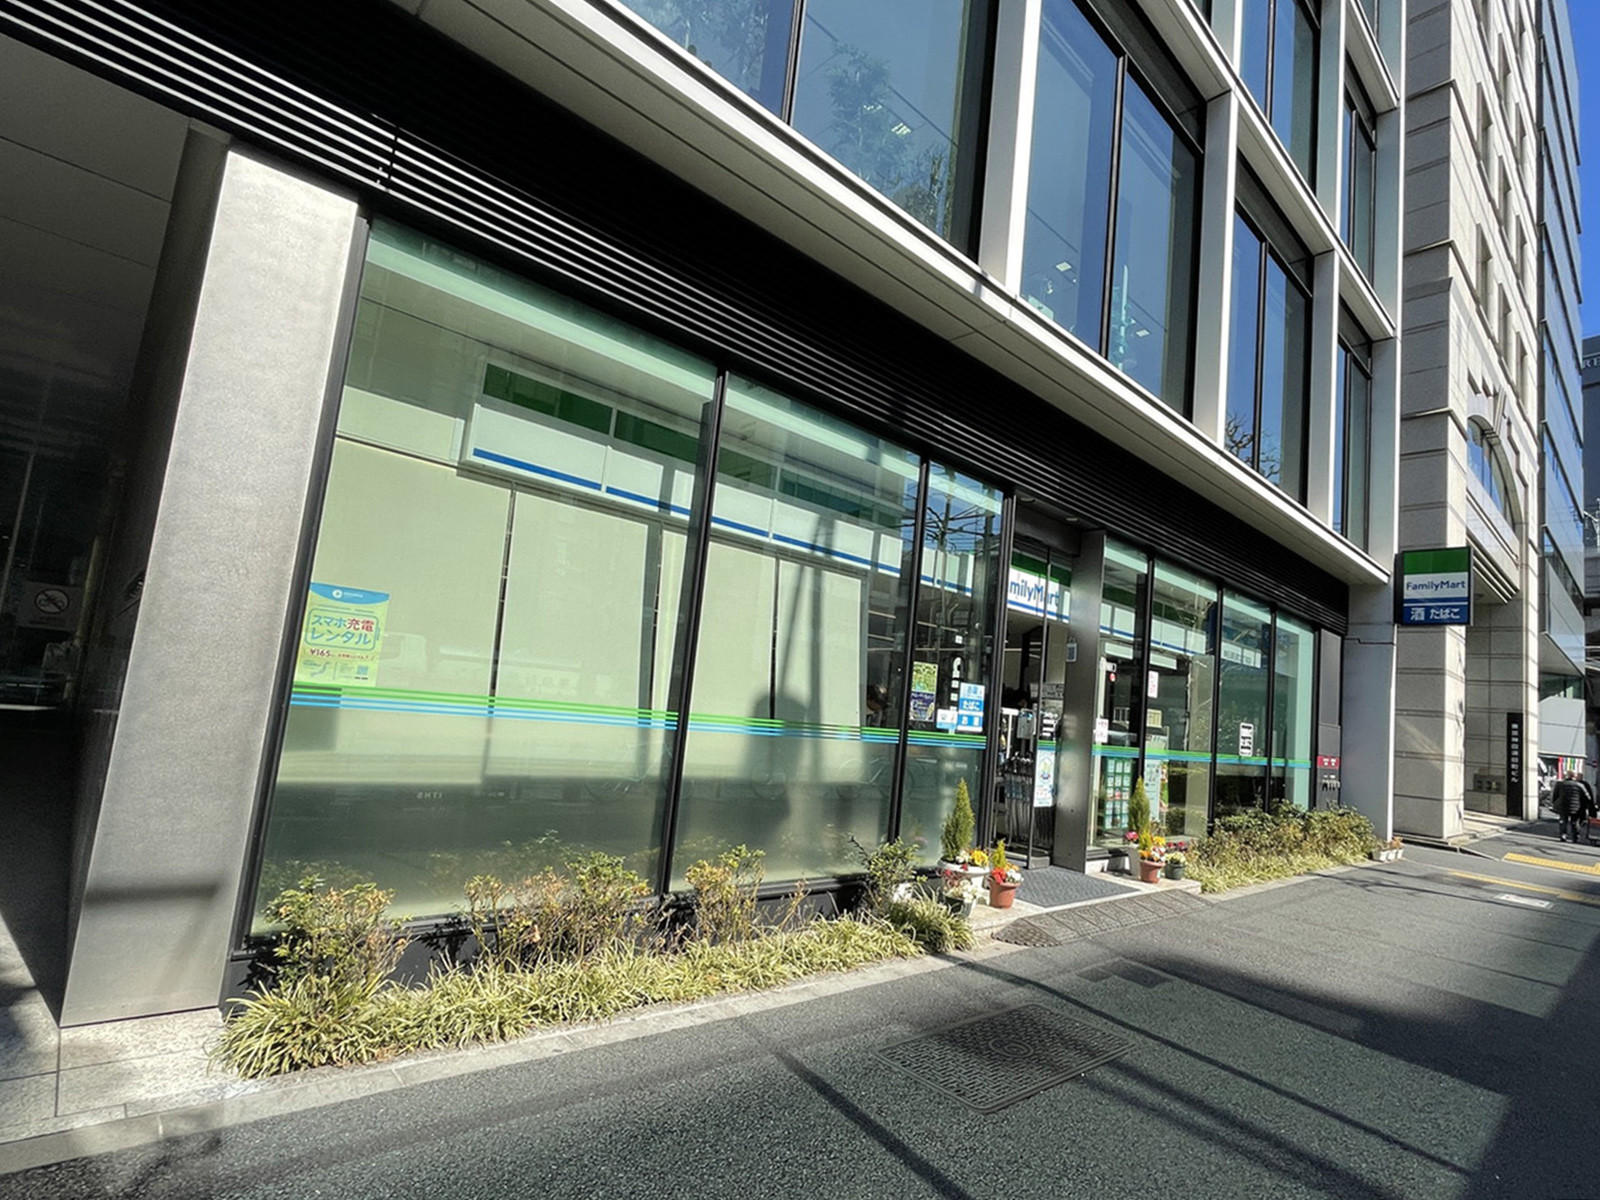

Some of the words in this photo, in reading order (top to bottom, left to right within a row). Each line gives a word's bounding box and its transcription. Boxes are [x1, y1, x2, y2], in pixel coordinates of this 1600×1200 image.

[1406, 581, 1465, 591] FamilyMart
[1410, 607, 1425, 620] 酒
[1430, 607, 1460, 619] たばこ
[311, 614, 375, 632] スマホ充電
[311, 627, 372, 645] レンタル
